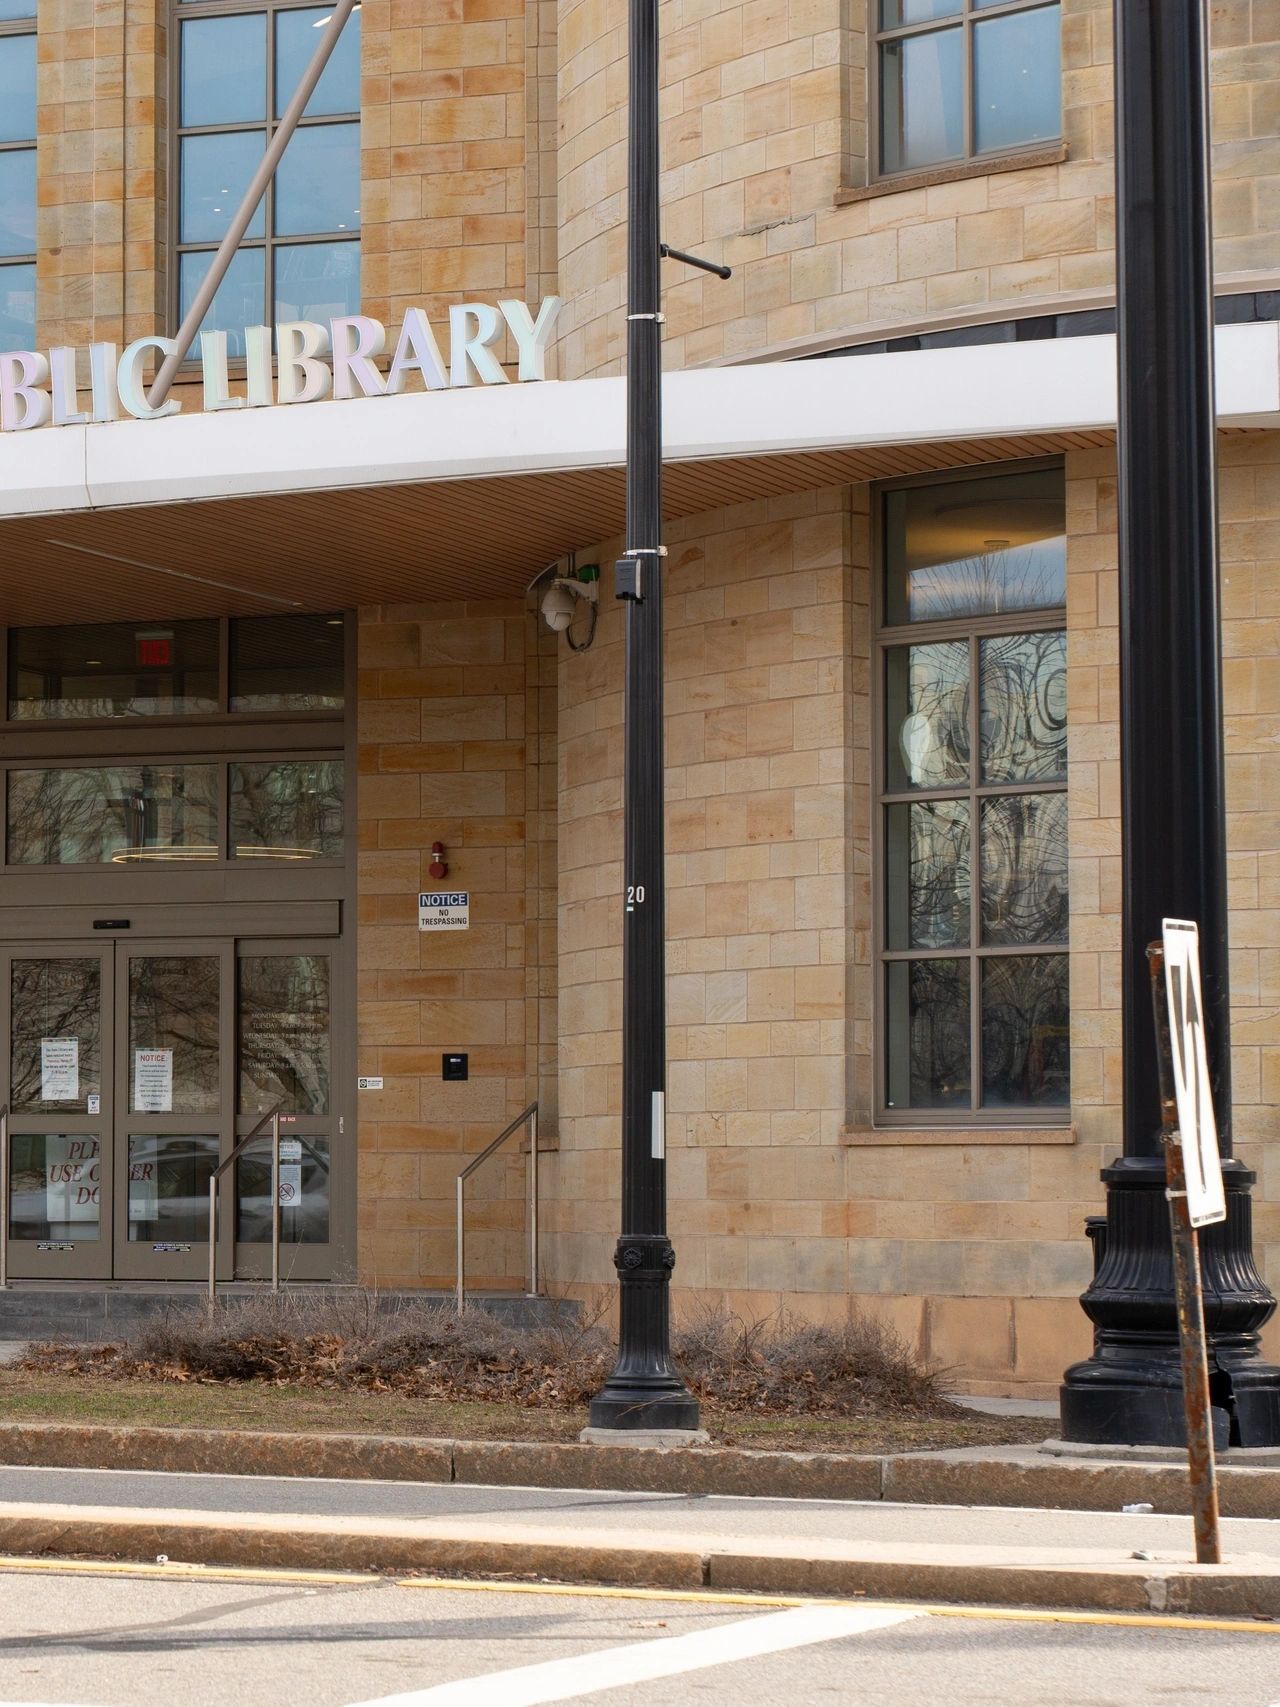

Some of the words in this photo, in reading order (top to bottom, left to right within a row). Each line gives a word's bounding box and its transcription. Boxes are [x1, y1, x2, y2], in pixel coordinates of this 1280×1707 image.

[200, 296, 561, 411] LIBRARY
[421, 894, 466, 906] NOTICE
[627, 886, 645, 903] 20
[421, 917, 467, 925] TRESPASSING
[50, 1164, 82, 1182] USE
